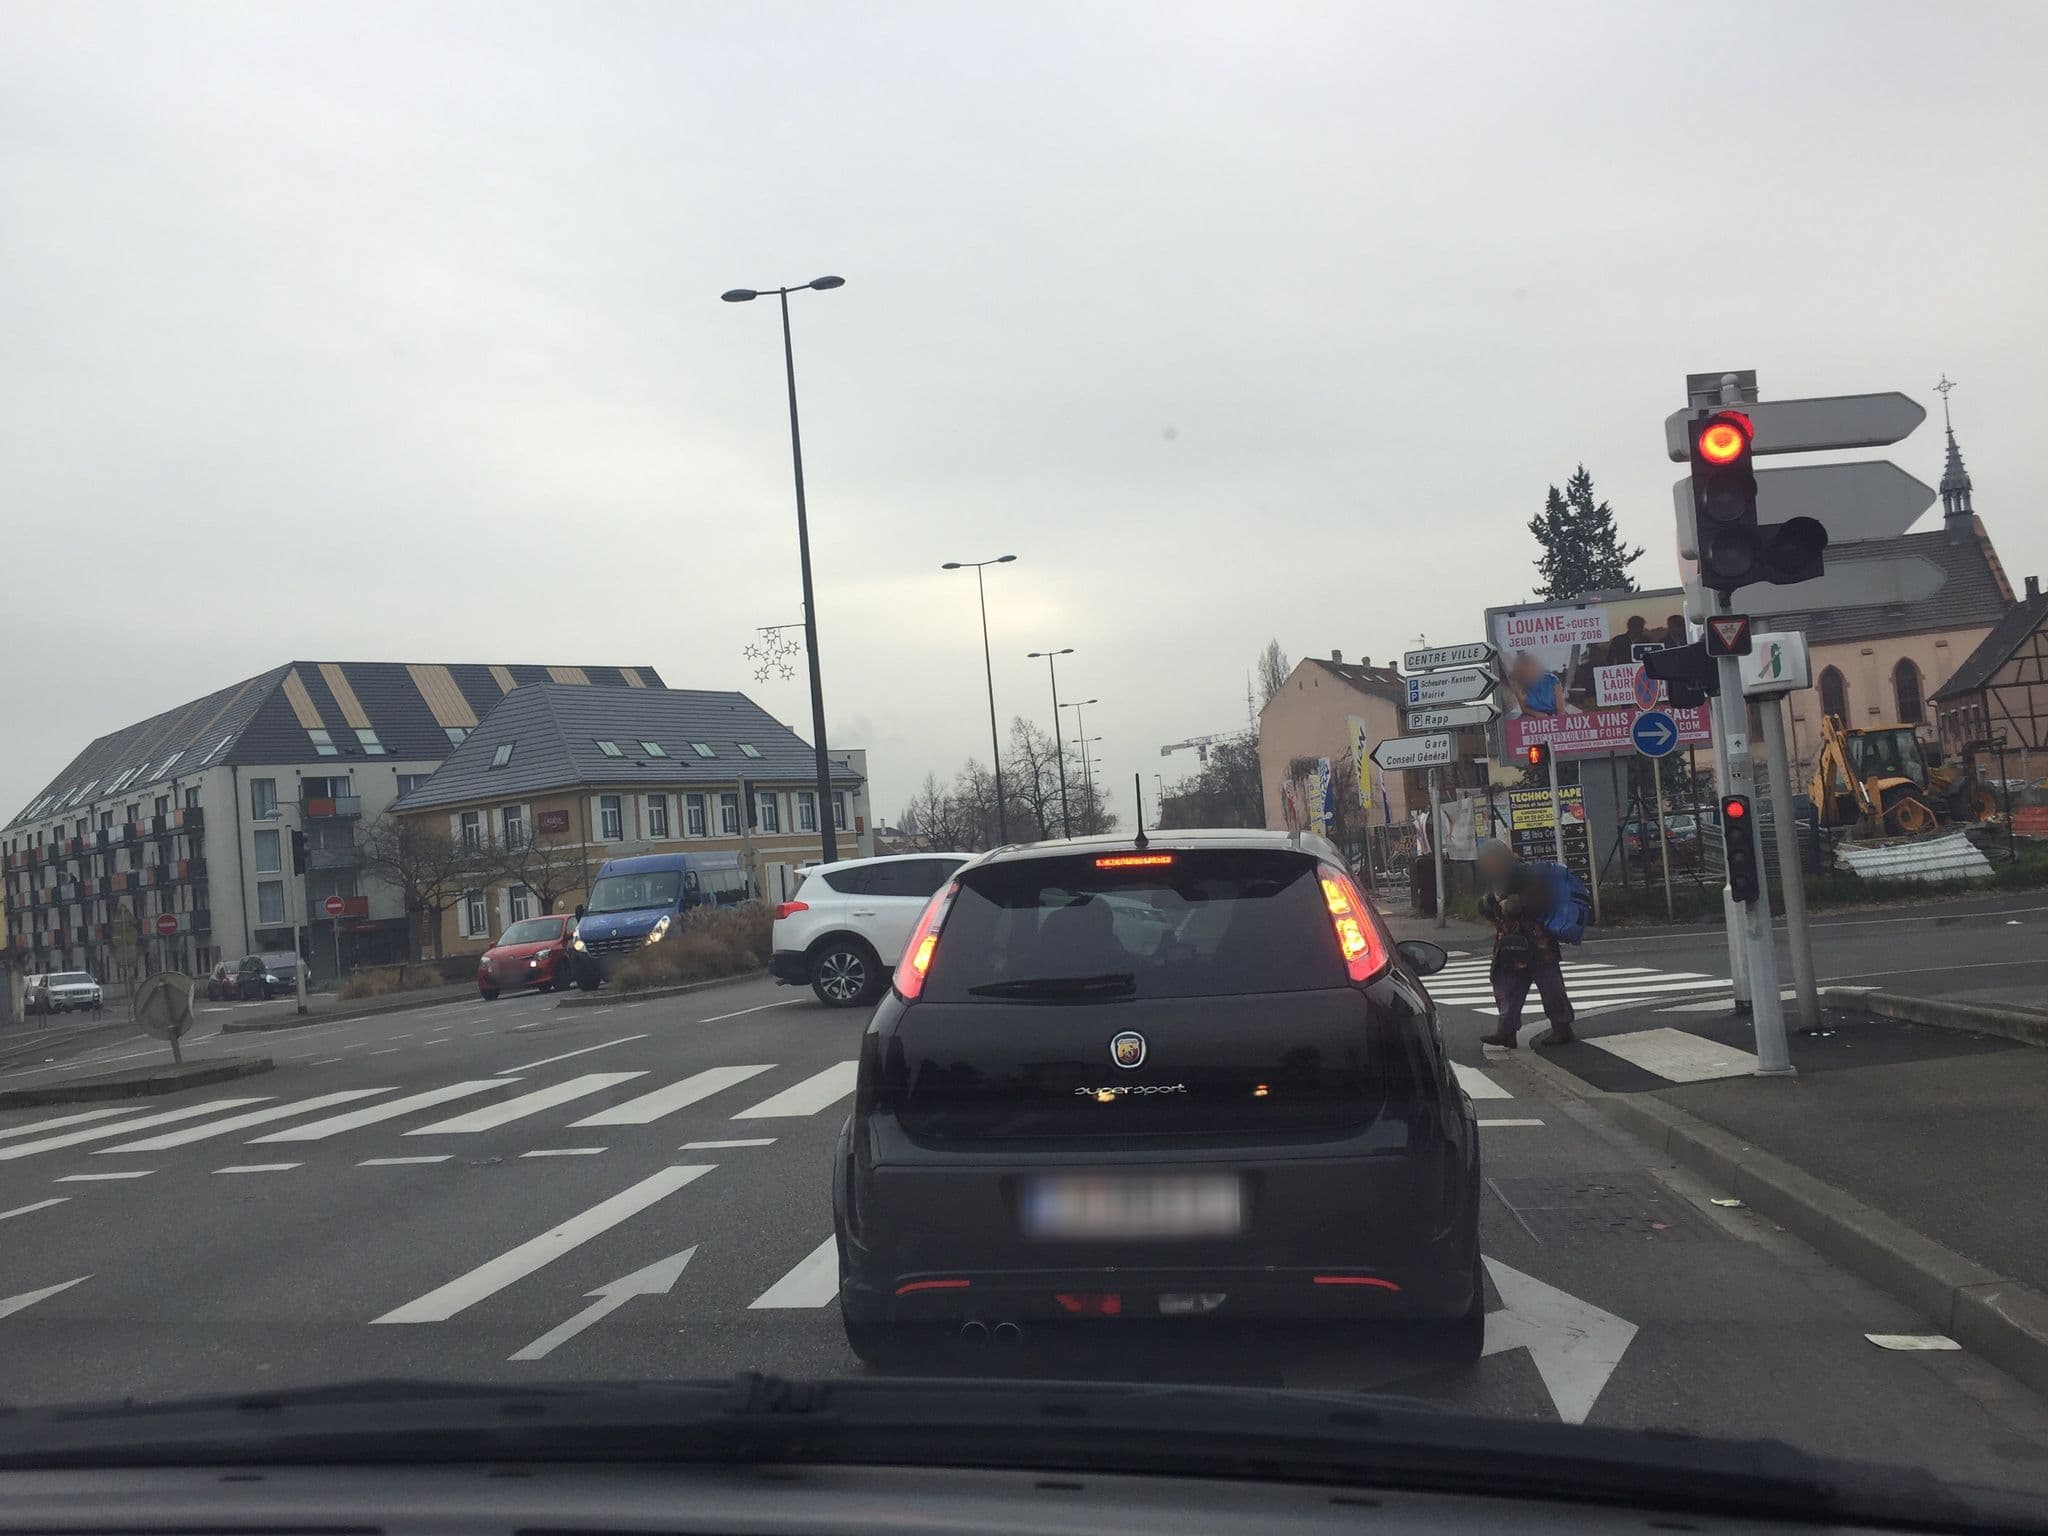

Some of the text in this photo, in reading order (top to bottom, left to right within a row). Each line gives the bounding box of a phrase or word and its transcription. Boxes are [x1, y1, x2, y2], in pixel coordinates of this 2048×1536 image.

[1508, 616, 1565, 635] LOUANE
[1509, 636, 1536, 648] JEUDI
[1541, 635, 1549, 644] 11
[1581, 630, 1602, 640] 2016
[1408, 648, 1479, 666] CENTRE VILLE
[1602, 667, 1634, 680] ALAIN
[1421, 692, 1445, 700] Mairie
[1604, 691, 1635, 703] MARDI
[1425, 715, 1449, 725] Rapp
[1521, 718, 1558, 734] FOIRE
[1565, 716, 1591, 730] AUX
[1597, 712, 1629, 727] VINS
[1425, 740, 1448, 749] Gare
[1386, 750, 1449, 765] Conseil Général
[1074, 1083, 1188, 1096] supersport
